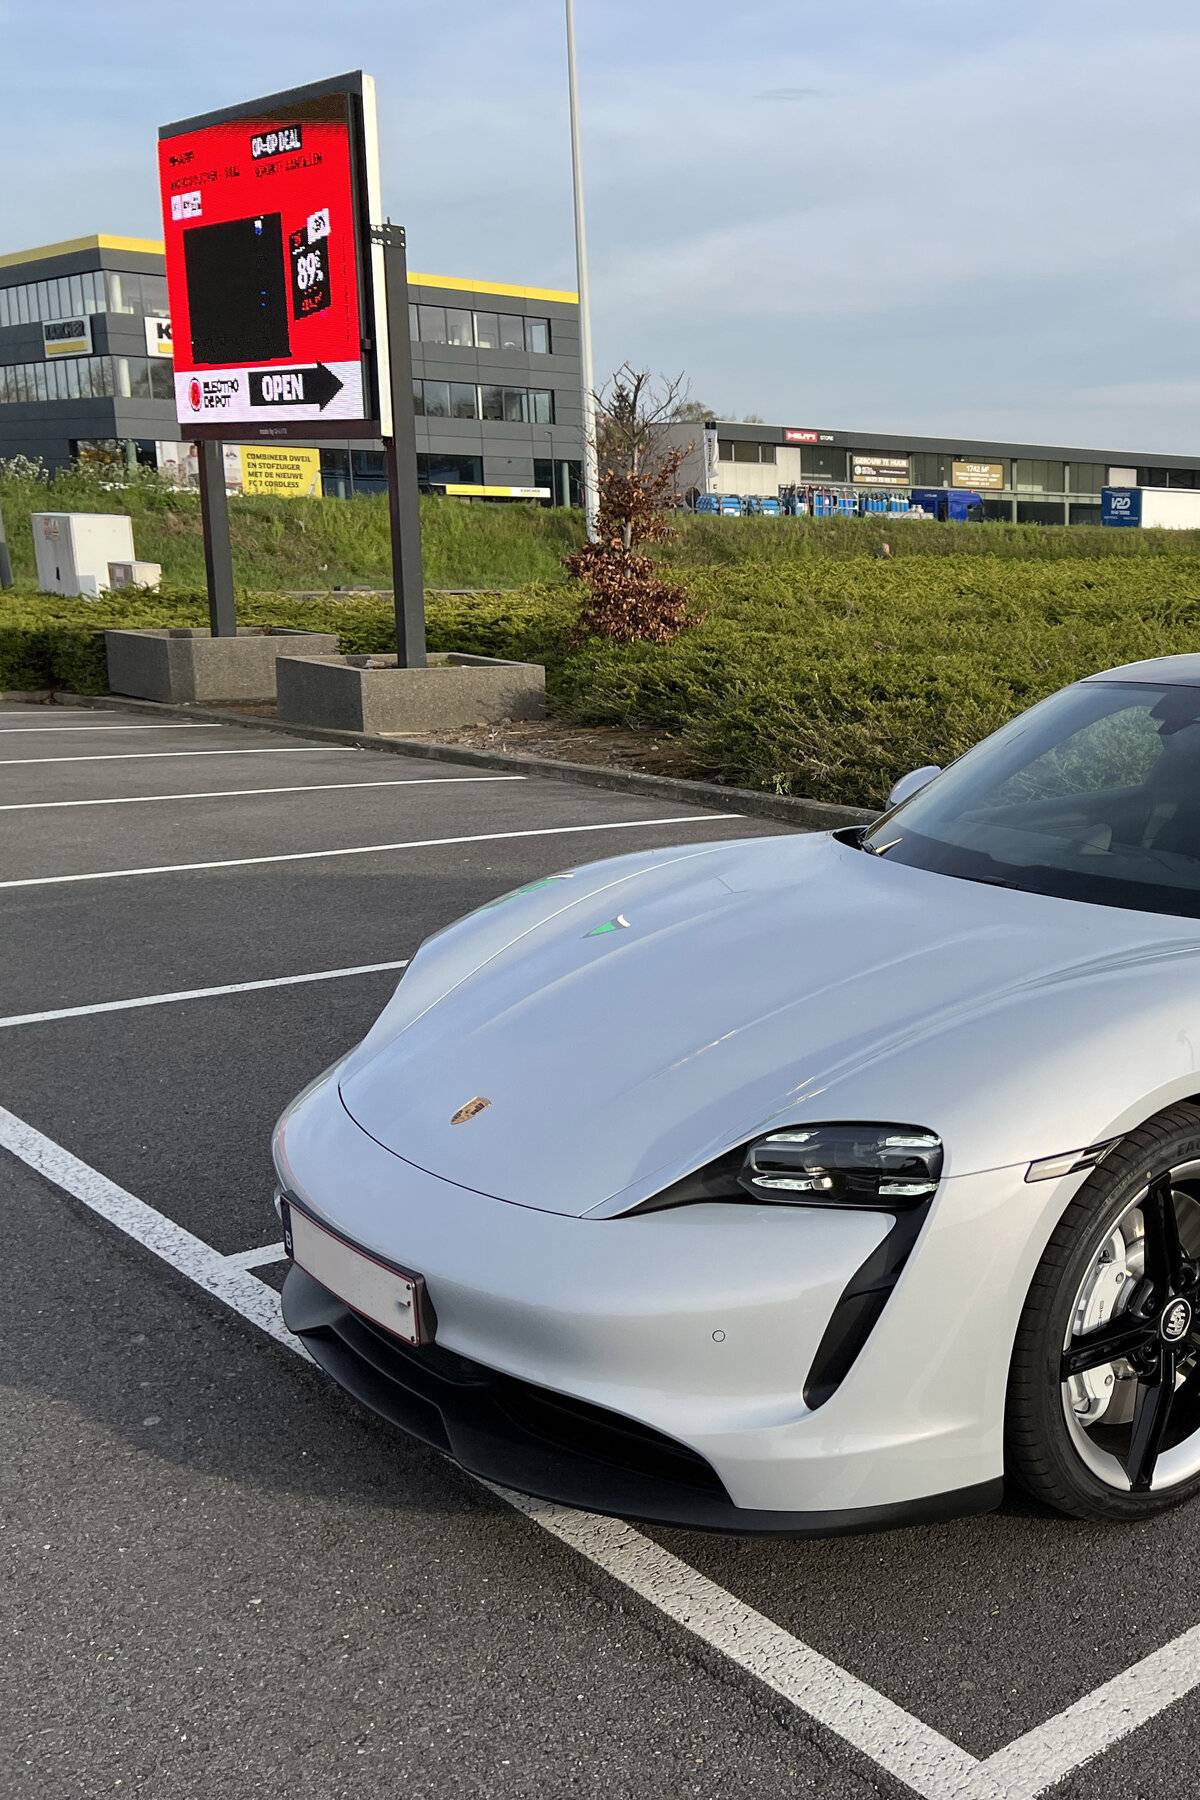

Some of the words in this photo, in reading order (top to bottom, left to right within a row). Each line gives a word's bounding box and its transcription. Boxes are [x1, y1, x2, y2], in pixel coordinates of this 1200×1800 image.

[203, 378, 239, 394] ELECTRO
[262, 374, 304, 402] OPEN
[204, 395, 231, 409] DEPOT
[246, 453, 288, 461] COMBINEER
[289, 455, 311, 463] DWEIL
[258, 462, 301, 470] STOFZUIGER
[275, 472, 304, 480] NIEUWE
[264, 480, 300, 488] CORDLESS
[285, 1230, 292, 1250] B
